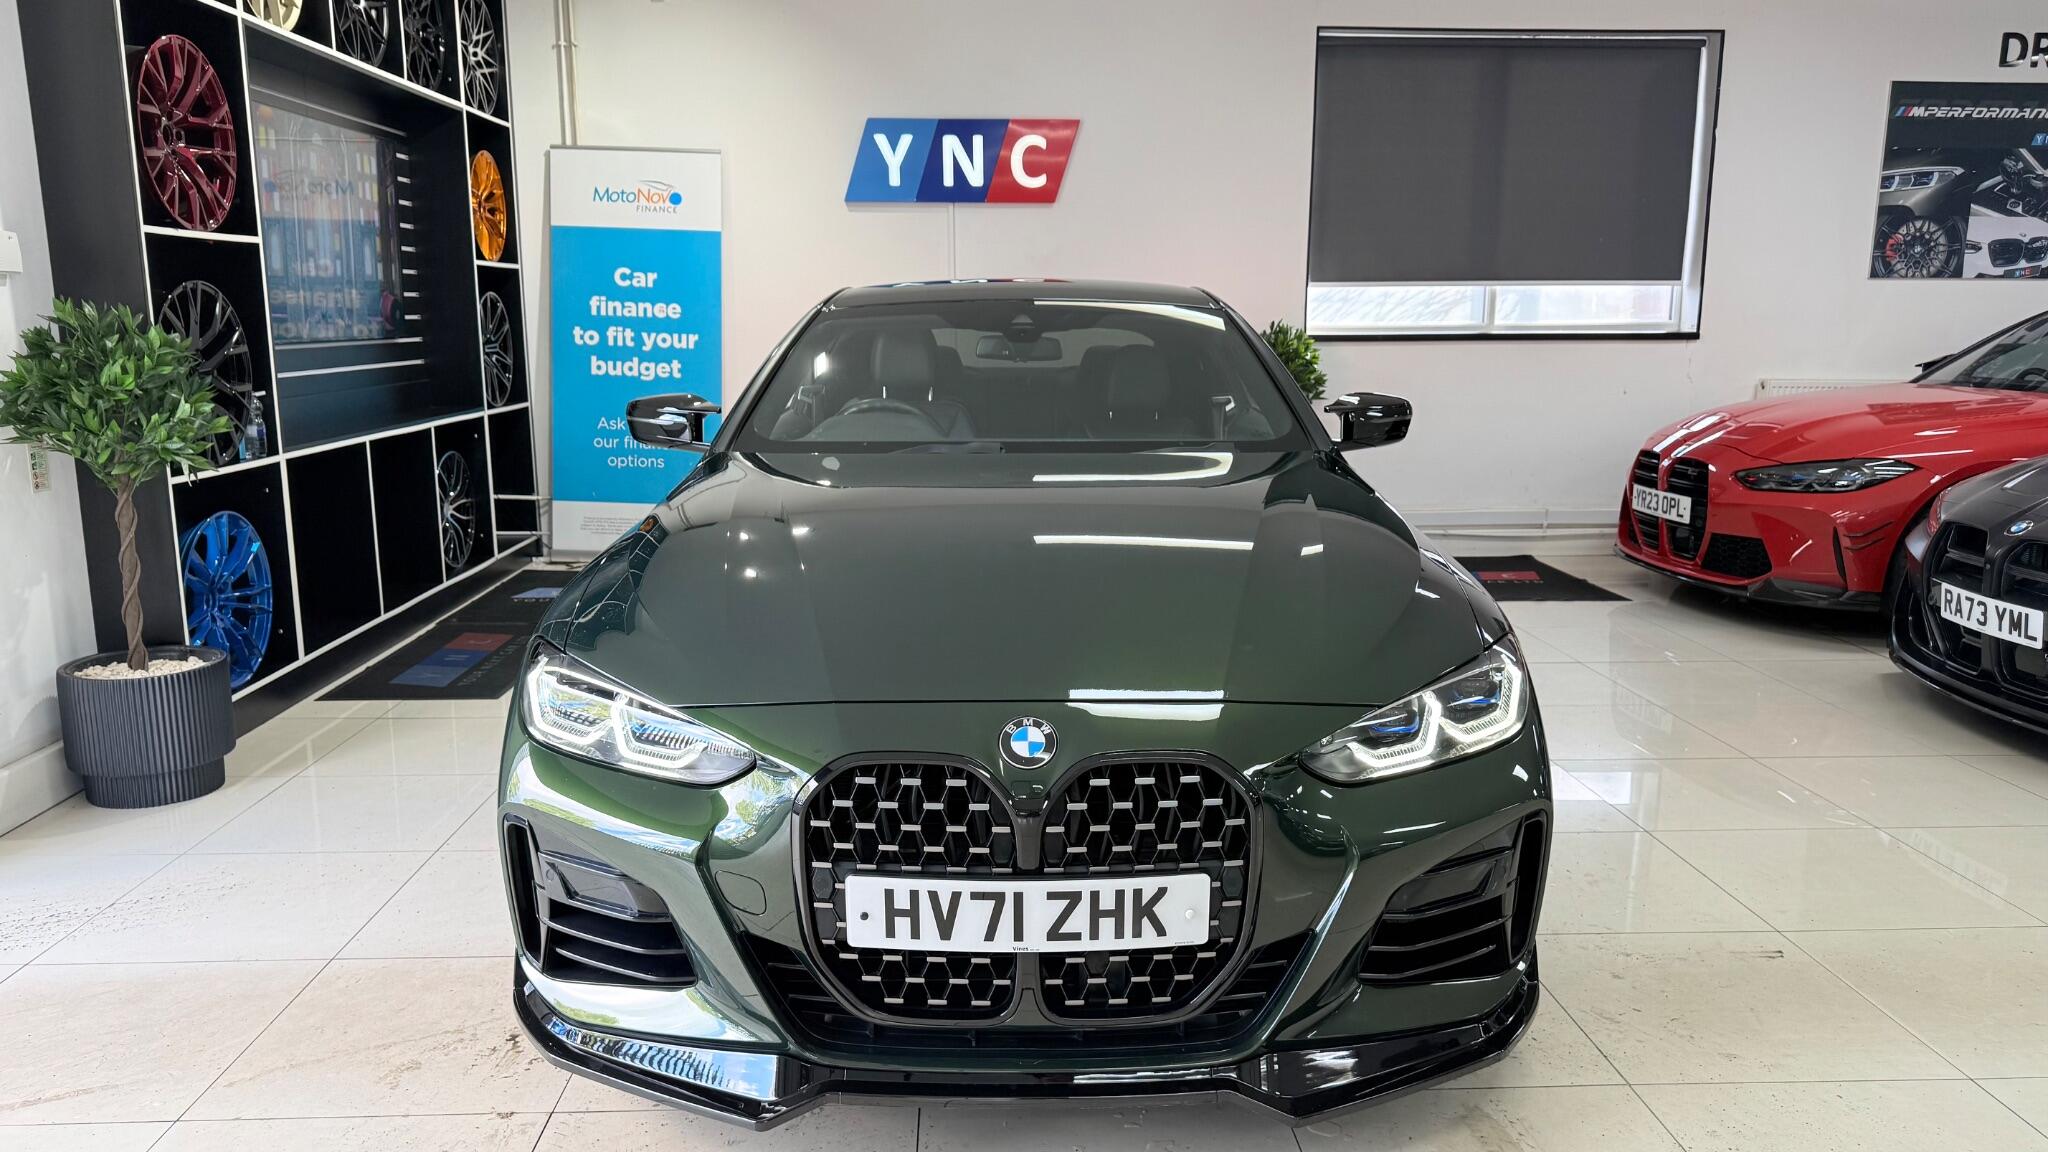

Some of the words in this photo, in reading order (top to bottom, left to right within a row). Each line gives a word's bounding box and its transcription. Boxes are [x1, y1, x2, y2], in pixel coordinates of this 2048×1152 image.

[872, 133, 1047, 189] YNC
[592, 185, 682, 206] MotoNovo
[636, 204, 679, 214] FINANCE
[613, 267, 658, 288] Car
[589, 295, 682, 319] finance
[572, 325, 600, 346] to
[606, 325, 635, 347] fit
[641, 331, 699, 352] your
[590, 355, 682, 381] budget
[597, 416, 626, 431] Ask
[593, 436, 620, 449] our
[607, 454, 665, 469] options
[1635, 488, 1659, 512] YR23
[1661, 496, 1684, 518] OPL
[1944, 587, 1988, 627] RA73
[1994, 605, 2037, 643] YML
[883, 887, 1025, 942] HV71
[1045, 886, 1169, 942] ZHK
